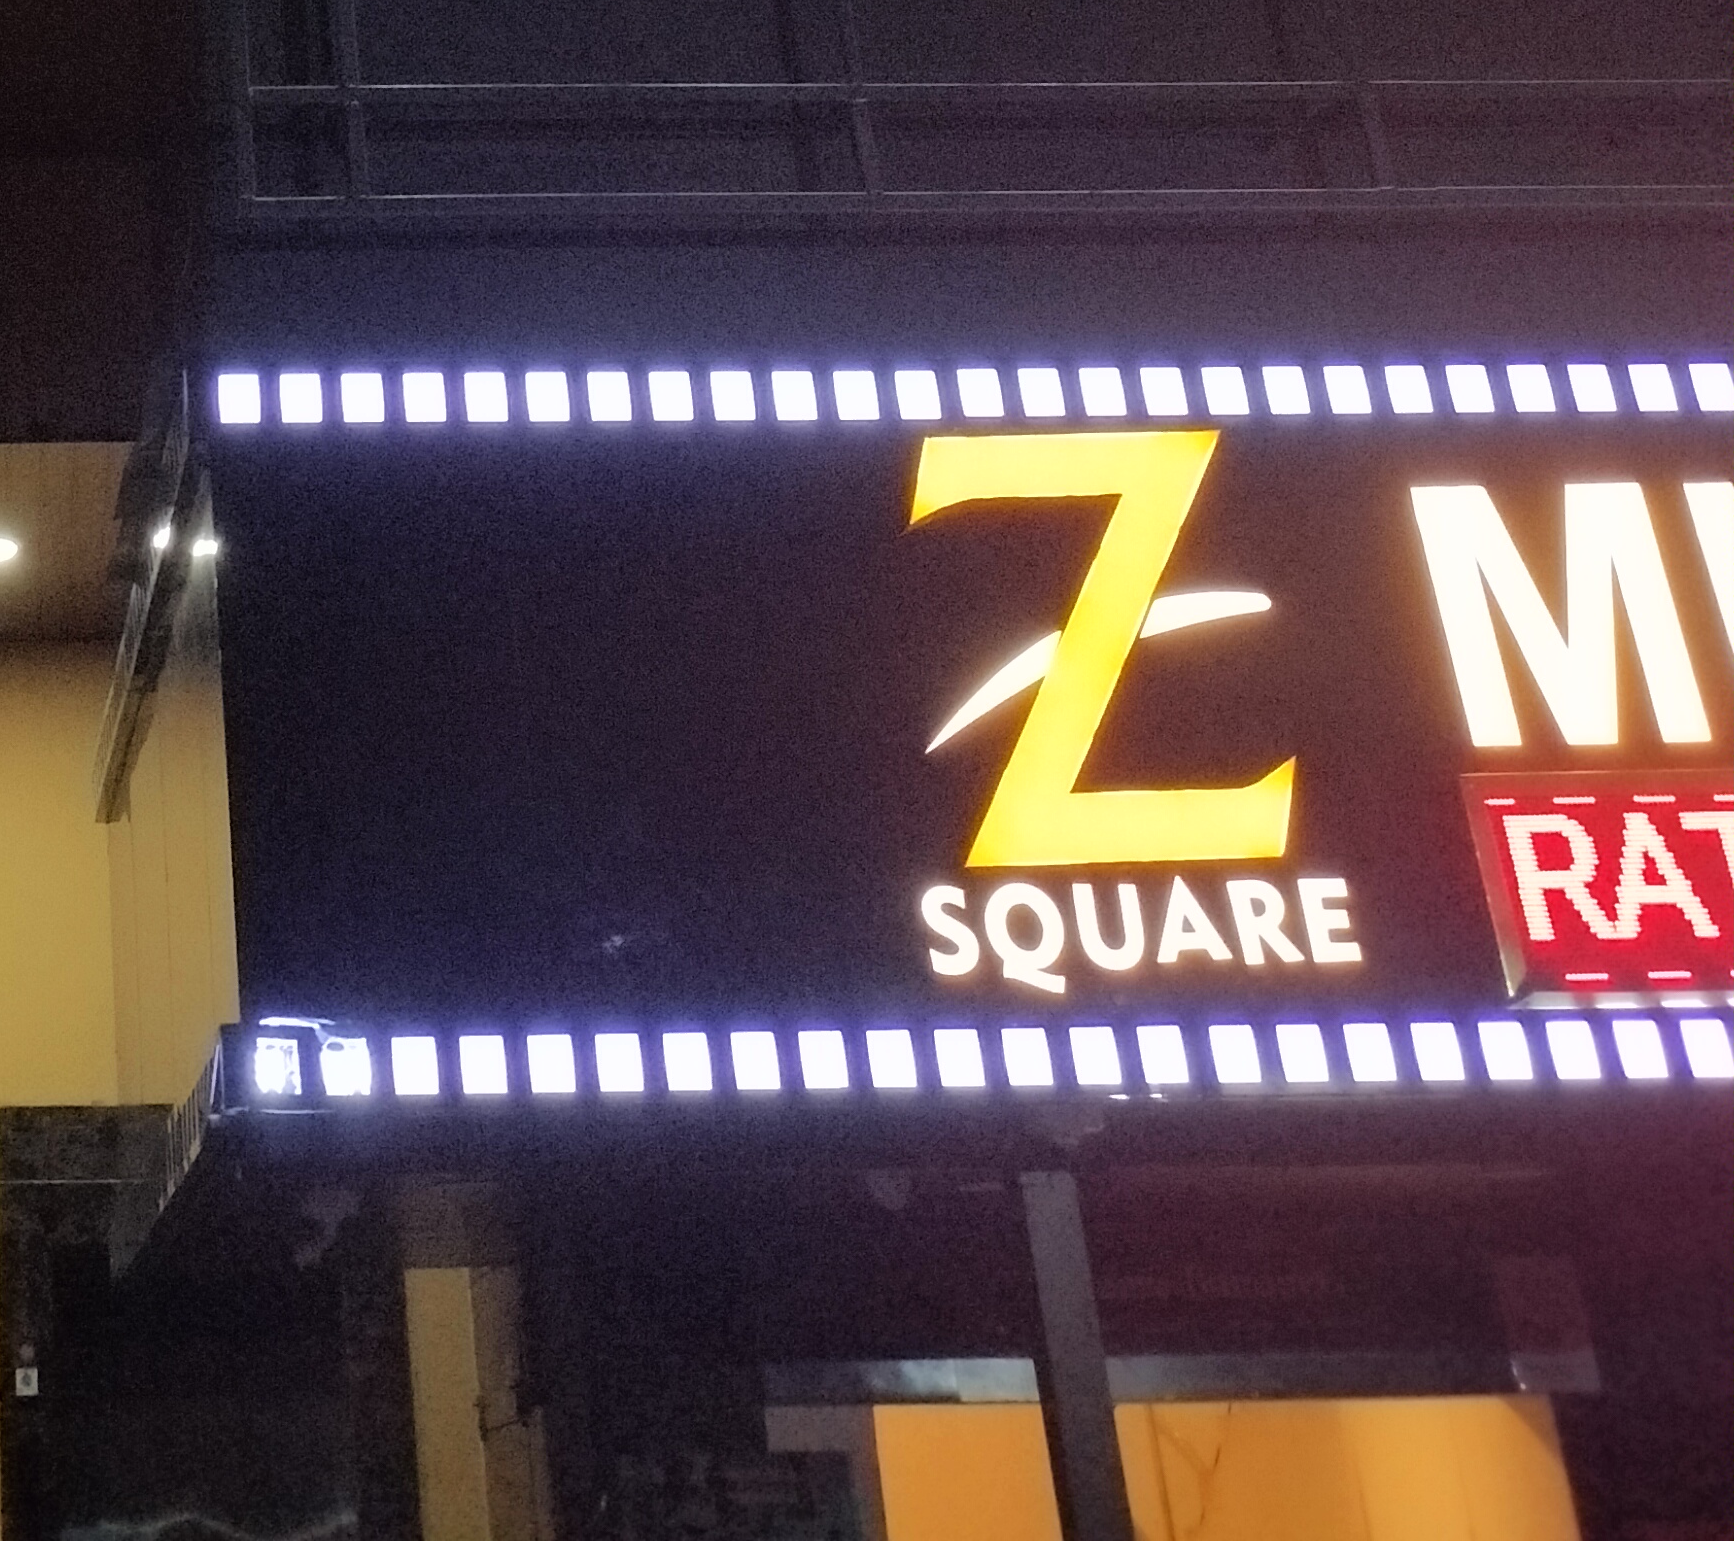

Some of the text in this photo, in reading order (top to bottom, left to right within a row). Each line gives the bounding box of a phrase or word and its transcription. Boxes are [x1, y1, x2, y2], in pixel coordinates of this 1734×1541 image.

[906, 429, 1296, 868] Z
[1409, 481, 1734, 747] M
[919, 875, 1363, 995] SQUARE
